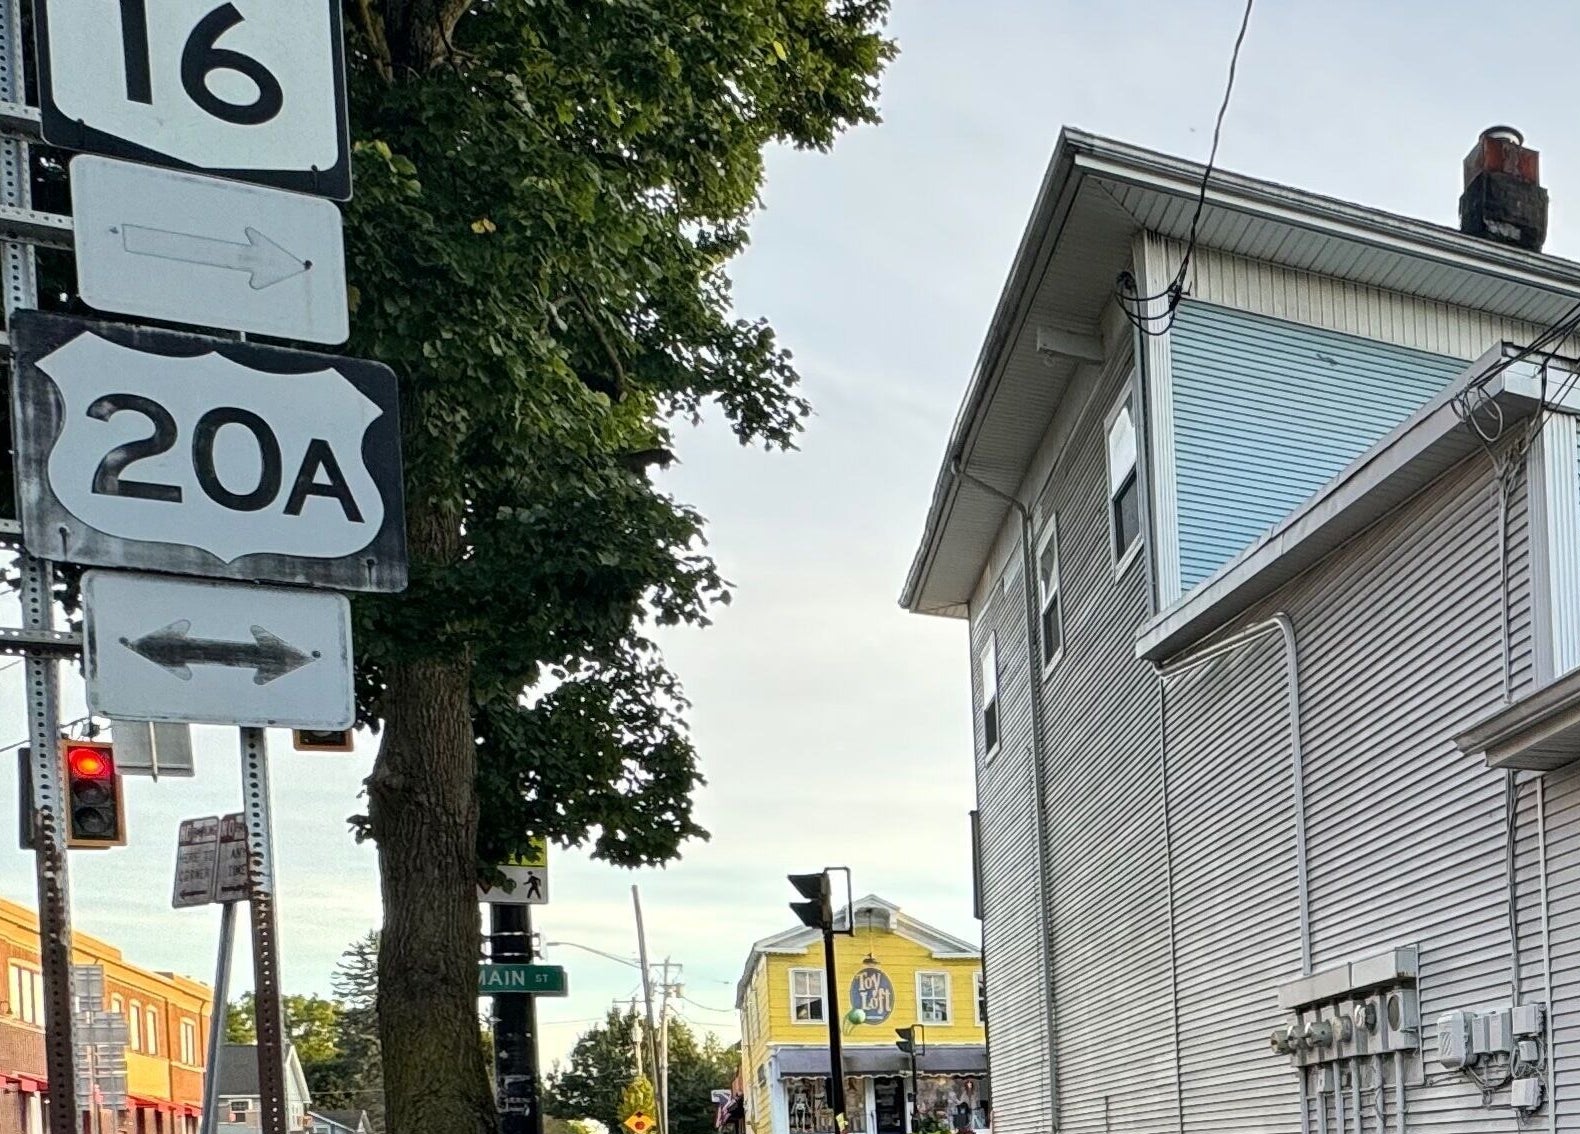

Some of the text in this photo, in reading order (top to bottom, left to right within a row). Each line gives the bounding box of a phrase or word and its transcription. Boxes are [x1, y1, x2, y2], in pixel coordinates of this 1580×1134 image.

[118, 0, 284, 126] 16
[86, 393, 366, 524] 20A
[535, 973, 549, 983] ST
[860, 988, 892, 1014] Loft
